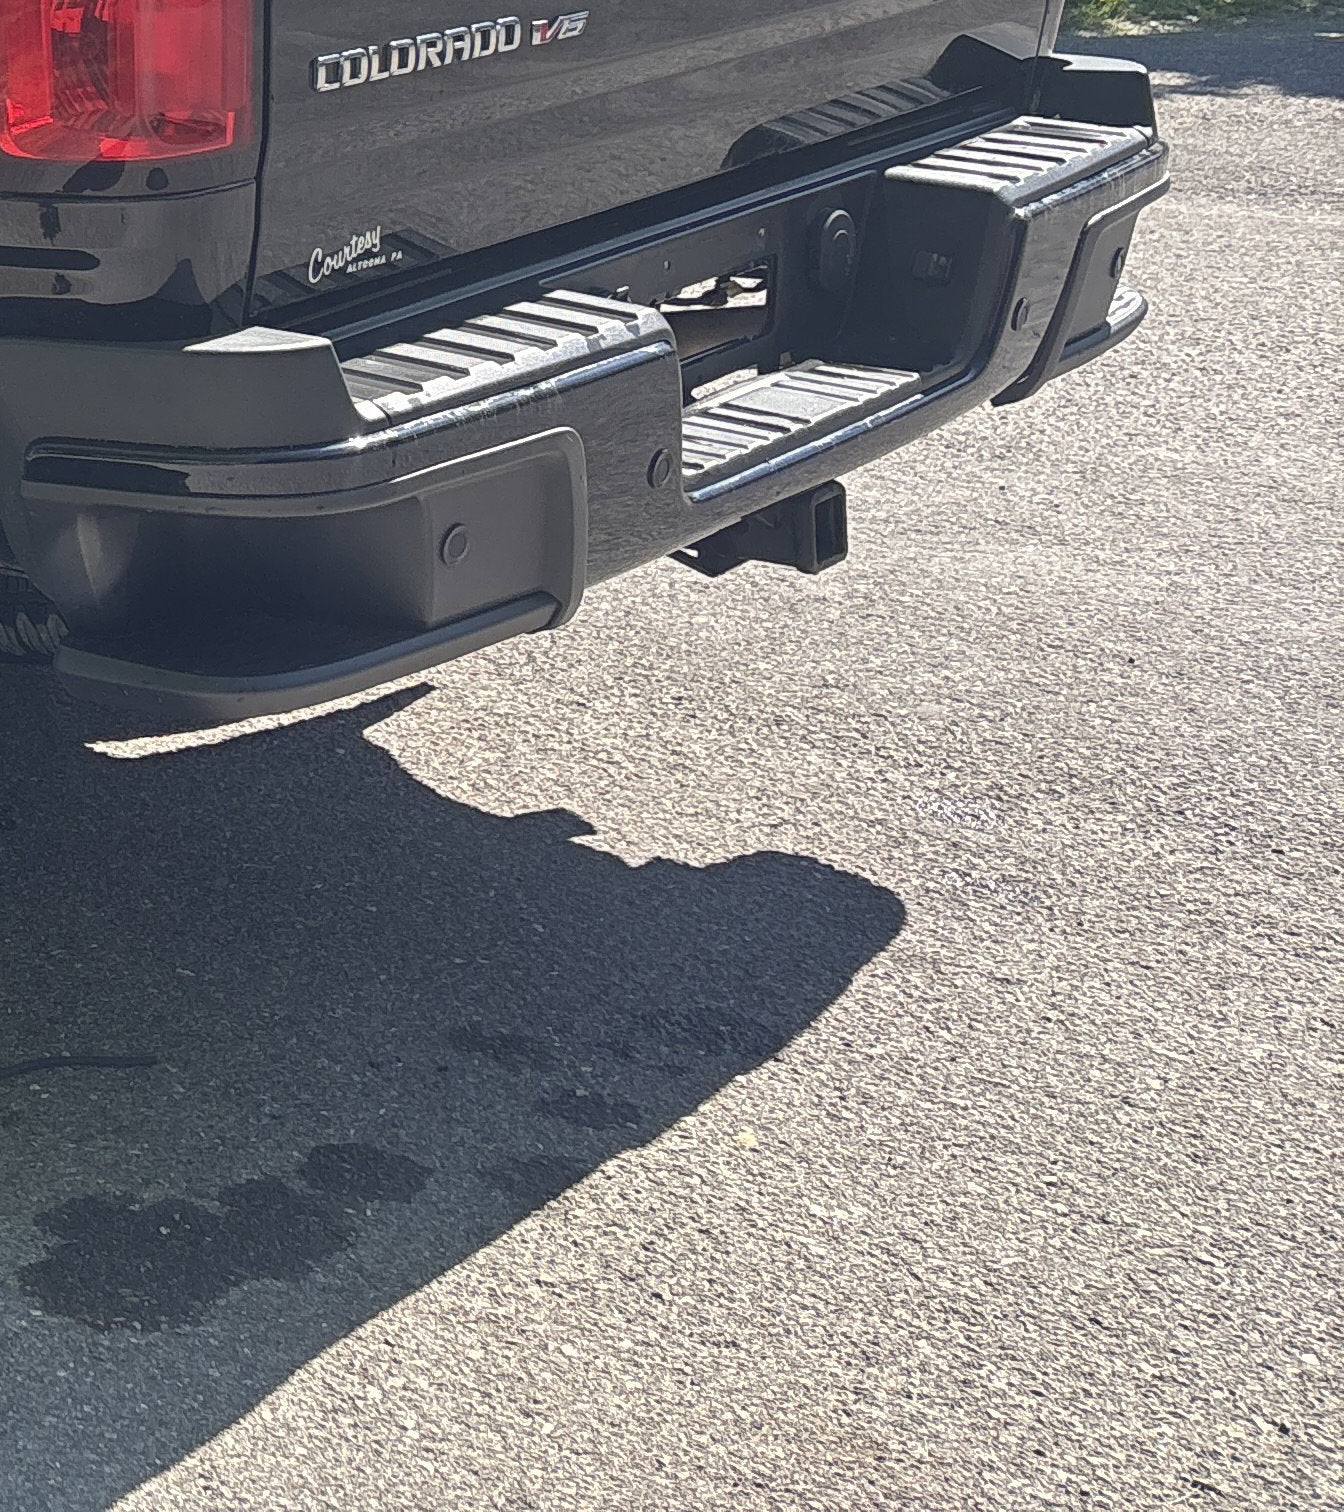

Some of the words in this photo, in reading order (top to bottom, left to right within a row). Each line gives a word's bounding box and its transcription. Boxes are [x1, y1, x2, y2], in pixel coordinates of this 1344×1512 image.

[311, 15, 522, 93] COLORADO
[531, 10, 590, 46] V6
[308, 226, 382, 283] Courtesy
[391, 250, 403, 262] PA
